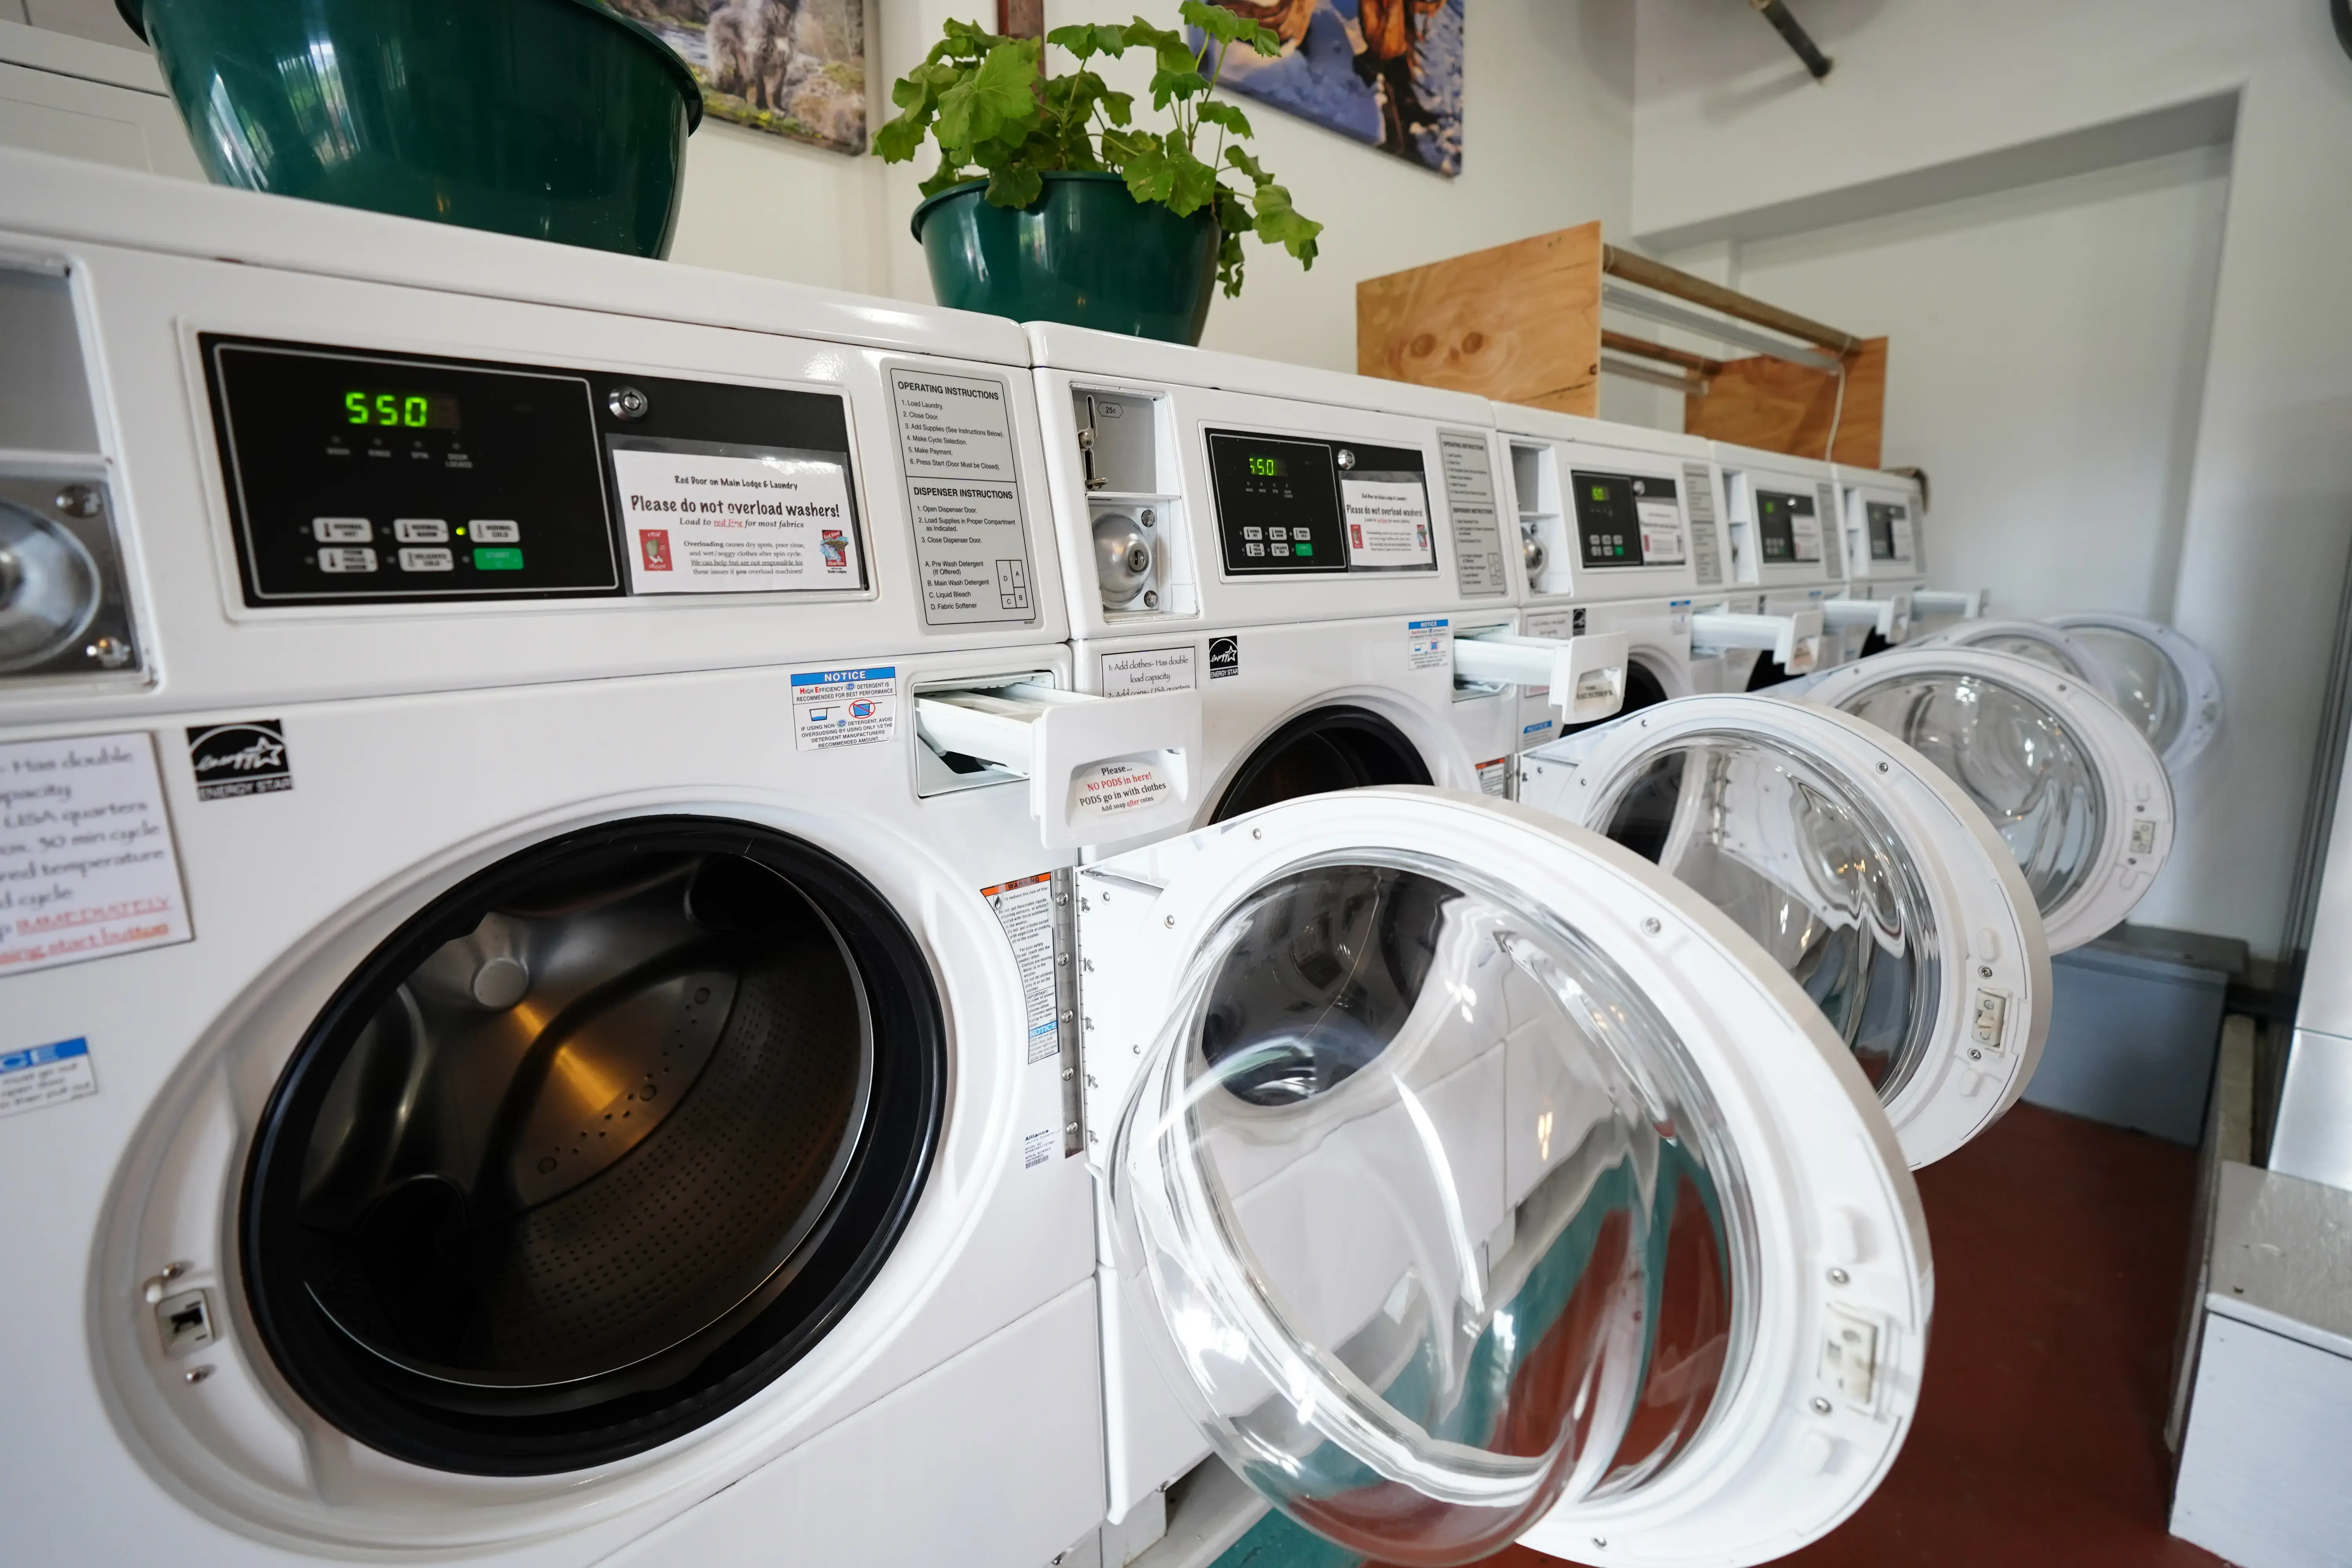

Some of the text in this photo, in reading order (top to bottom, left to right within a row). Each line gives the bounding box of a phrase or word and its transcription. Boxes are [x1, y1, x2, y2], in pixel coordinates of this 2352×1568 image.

[898, 381, 998, 400] OPERATING INSTRUCTIONS
[345, 392, 429, 427] 550
[922, 401, 943, 410] Laundry.
[922, 424, 944, 432] Supplies
[981, 463, 1000, 471] Closed).
[674, 475, 689, 484] Red
[691, 476, 707, 485] Door
[720, 478, 740, 486] Main
[742, 479, 762, 489] Lodge
[769, 480, 797, 491] Laundry
[914, 487, 1013, 499] DISPENSER INSTRUCTIONS
[631, 495, 839, 517] Please do not overload washers!
[1346, 504, 1364, 514] Please
[1365, 506, 1371, 514] do
[1372, 507, 1380, 515] not
[1381, 507, 1402, 516] overload
[714, 519, 728, 527] red
[744, 519, 756, 528] for
[778, 520, 804, 529] fabrics
[1114, 661, 1128, 670] Add
[1169, 655, 1188, 665] double
[824, 671, 866, 682] NOTICE
[1130, 673, 1170, 684] load capacity
[1210, 670, 1227, 678] ENERGY
[797, 693, 834, 702] RECOMMENDED
[801, 729, 837, 737] OVERSUDSING
[843, 730, 885, 739] MANUFACTURERS
[818, 739, 857, 748] RECOMMENDED
[1087, 782, 1100, 791] NO
[1101, 777, 1122, 788] PODS
[1132, 772, 1151, 782] here!
[1079, 795, 1102, 806] PODS
[1103, 794, 1112, 803] go
[1123, 787, 1140, 797] with
[1141, 783, 1166, 793] clothes
[1008, 877, 1040, 890] WARNING
